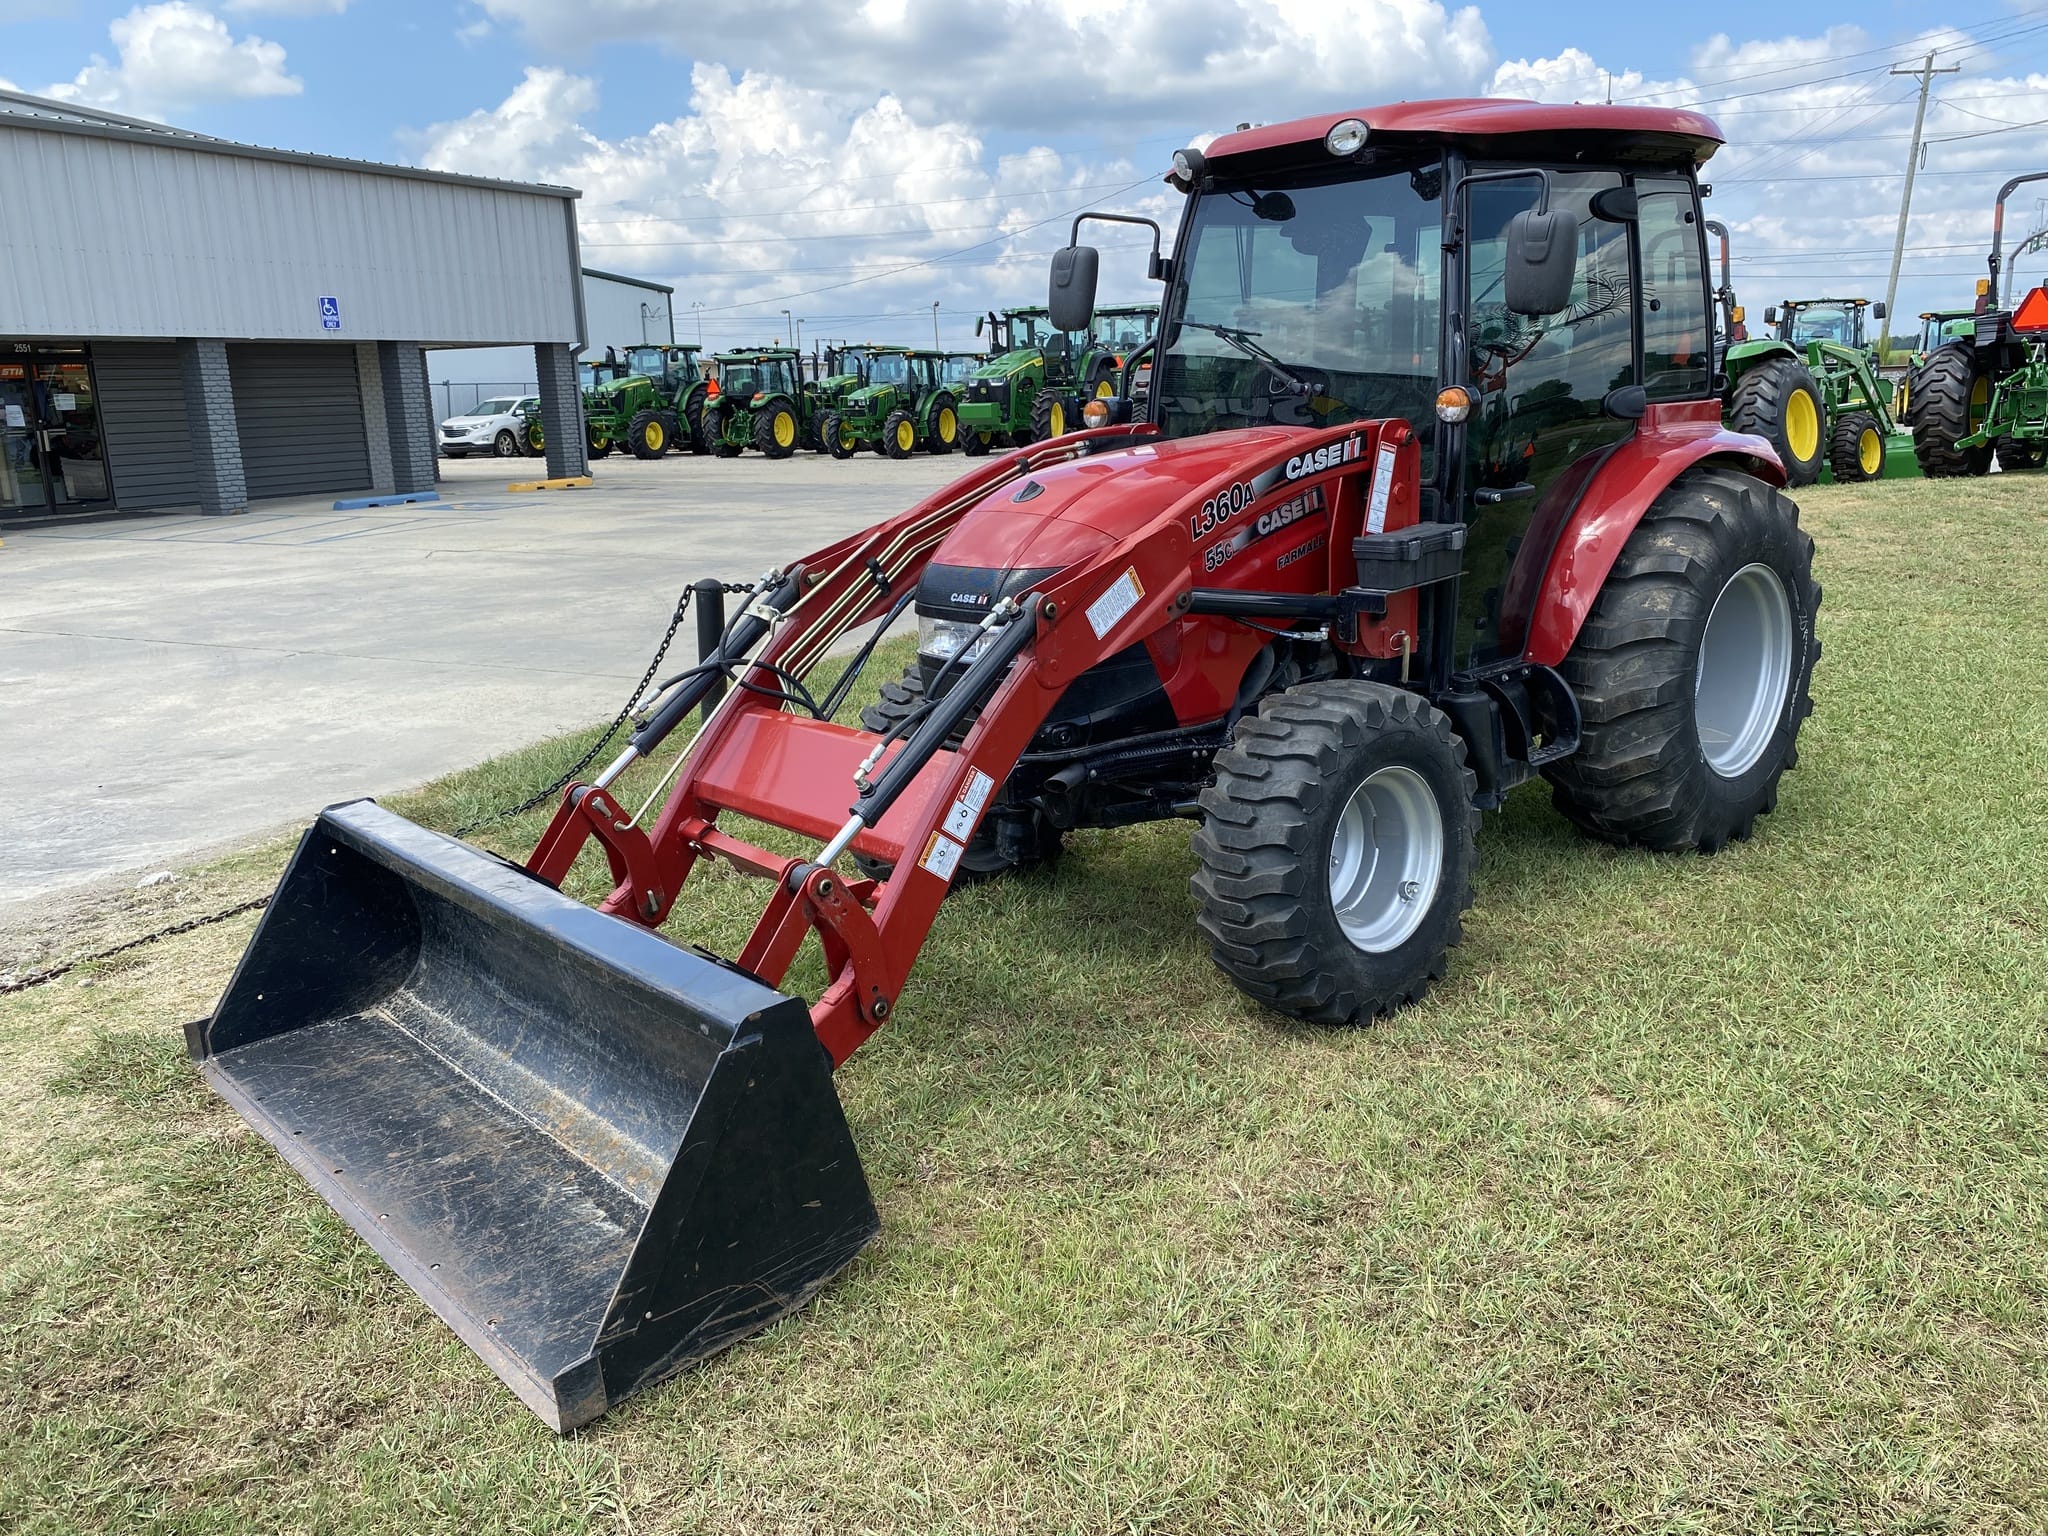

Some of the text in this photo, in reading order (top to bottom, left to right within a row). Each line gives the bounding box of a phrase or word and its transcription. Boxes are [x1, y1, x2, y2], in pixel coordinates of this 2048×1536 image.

[14, 343, 31, 353] 2551
[1286, 443, 1342, 480] CASE
[1191, 481, 1256, 542] L360A
[1257, 496, 1305, 536] CASE
[1205, 540, 1234, 572] 55C
[1277, 535, 1325, 570] FARMALL
[950, 592, 977, 604] CASE
